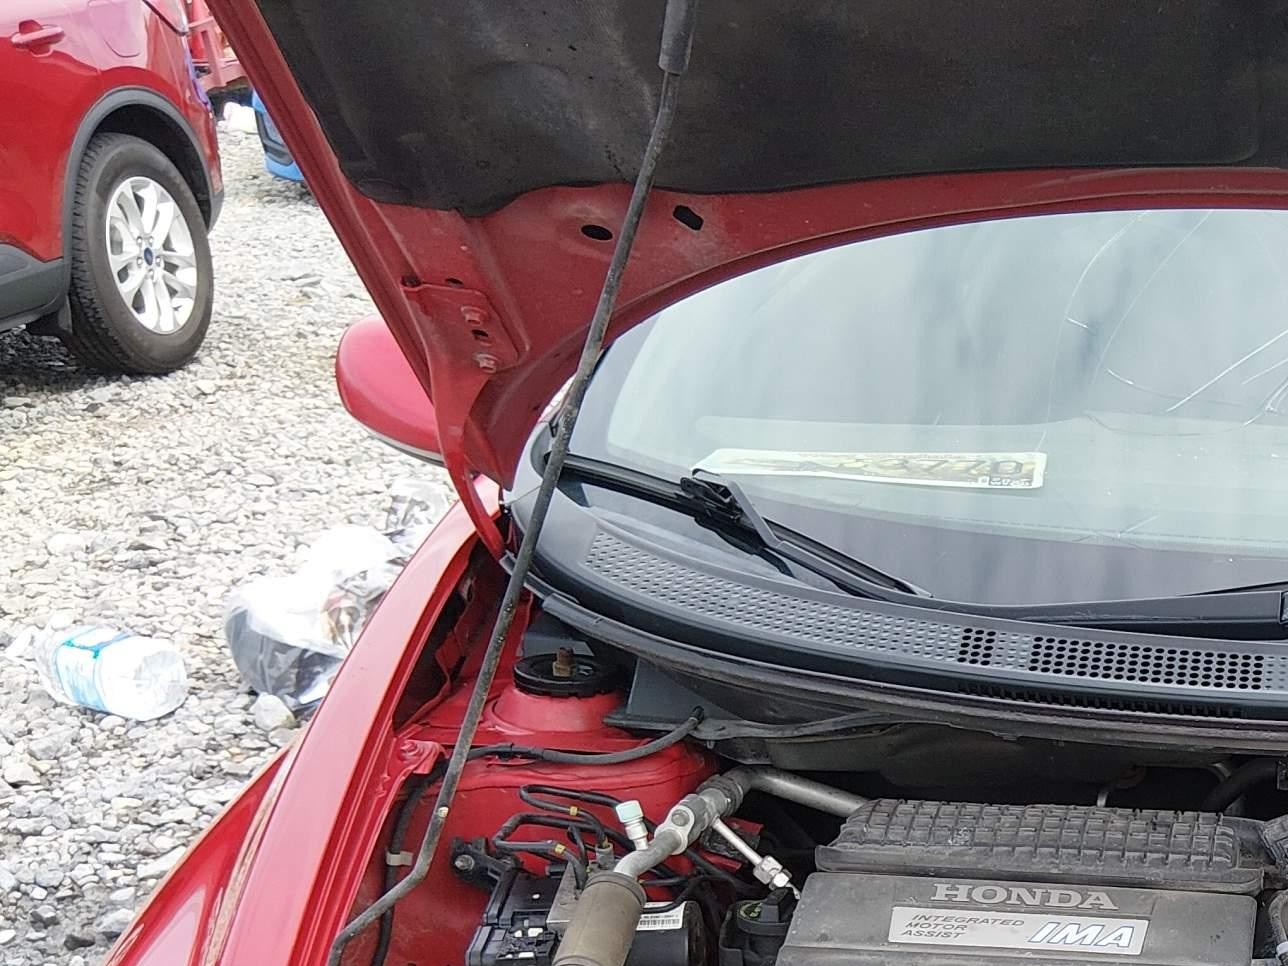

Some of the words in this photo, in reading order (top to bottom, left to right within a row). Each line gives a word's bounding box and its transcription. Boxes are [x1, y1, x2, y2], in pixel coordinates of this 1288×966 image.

[930, 883, 1119, 910] HONDA
[904, 921, 968, 932] MOTOR
[911, 914, 1024, 927] INTEGRATED
[901, 929, 964, 939] ASSIST
[1028, 921, 1135, 949] IMA
